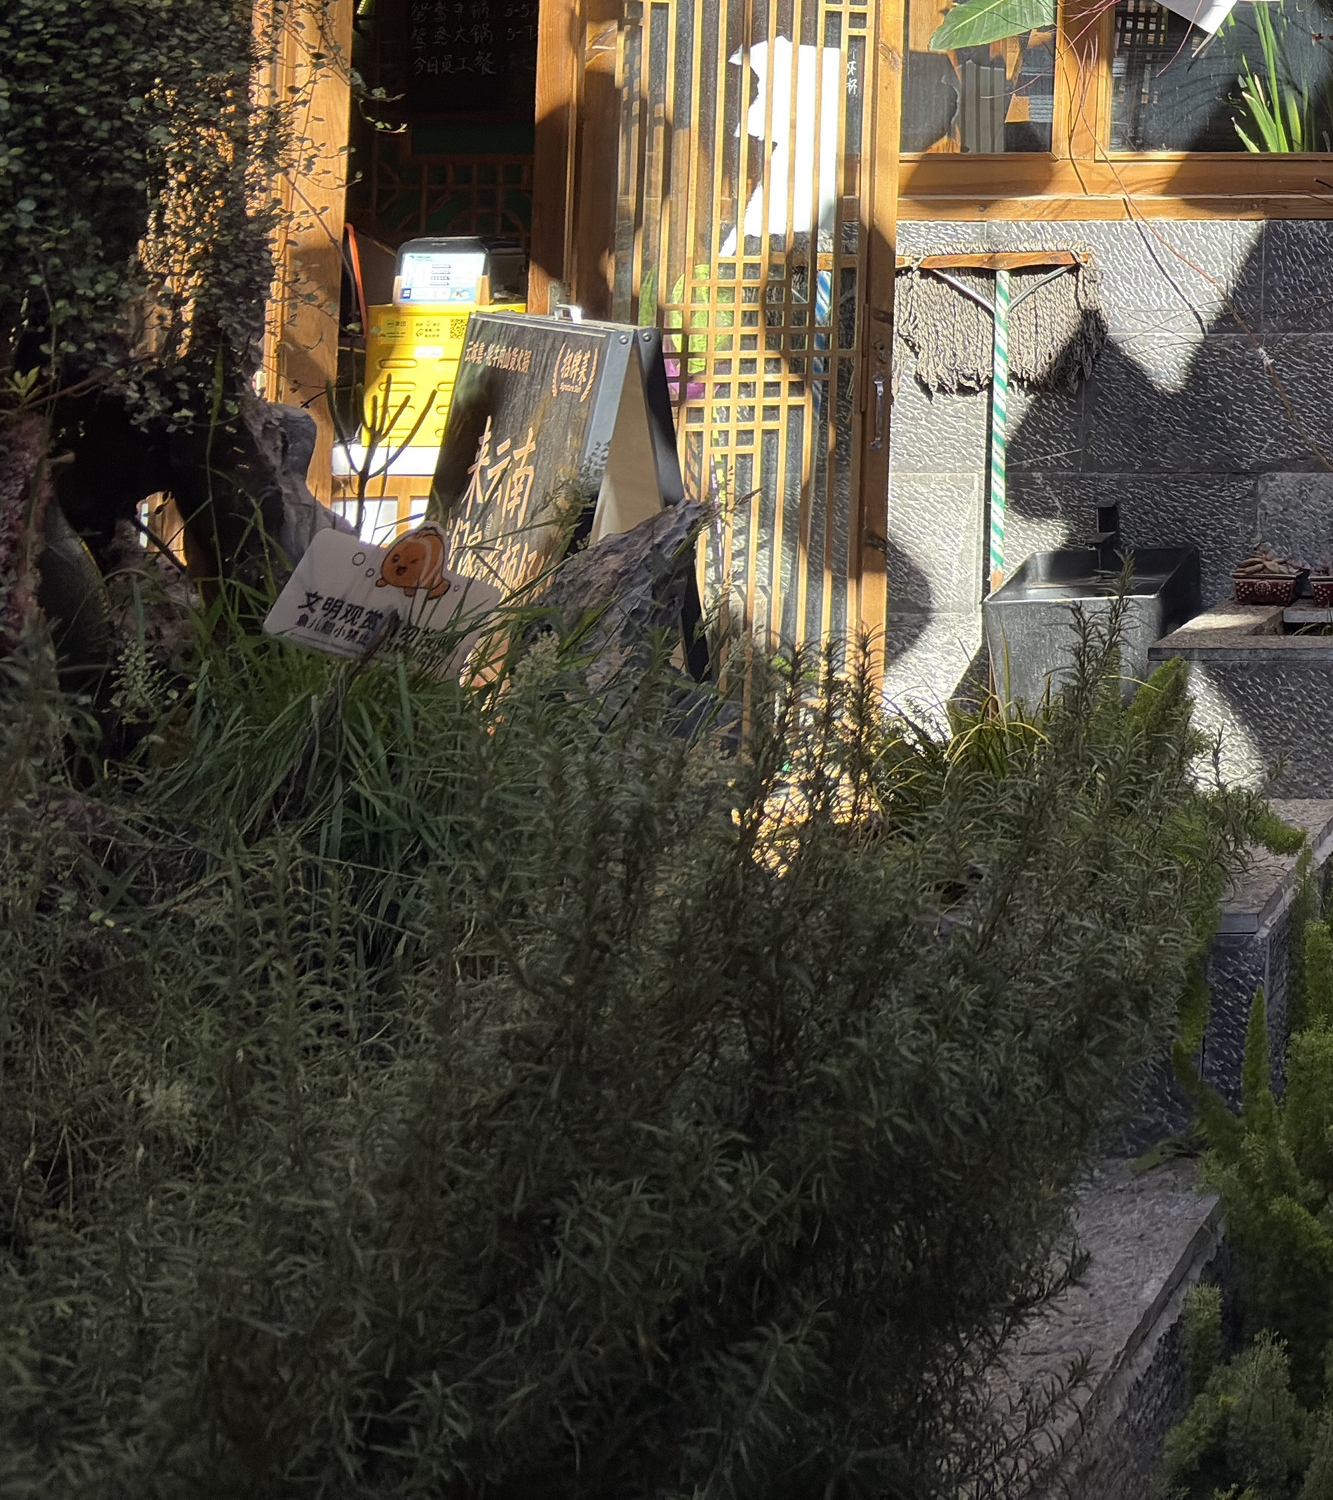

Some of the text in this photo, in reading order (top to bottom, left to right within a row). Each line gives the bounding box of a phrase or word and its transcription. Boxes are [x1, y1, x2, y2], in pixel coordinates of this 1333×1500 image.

[561, 348, 592, 386] 招牌菜
[461, 415, 536, 528] 来云南
[298, 591, 384, 631] 文明观赏
